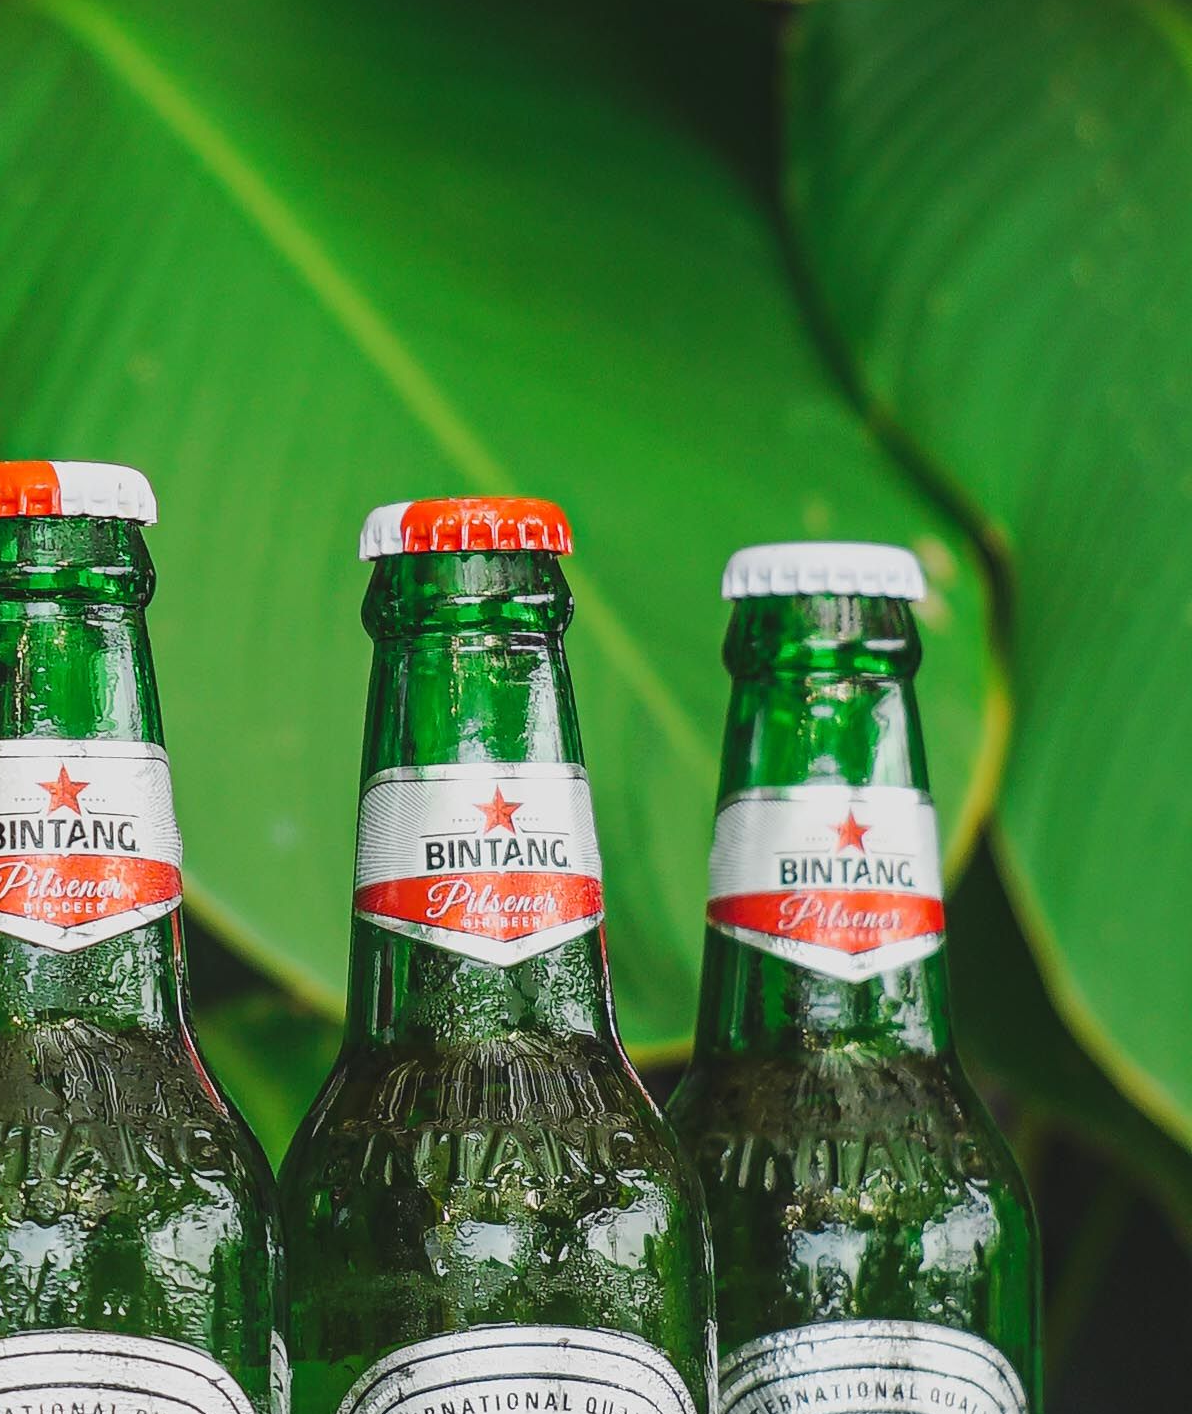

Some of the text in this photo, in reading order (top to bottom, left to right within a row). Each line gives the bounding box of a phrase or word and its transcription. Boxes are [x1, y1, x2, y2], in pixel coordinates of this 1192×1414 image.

[425, 838, 568, 871] BINTANG
[779, 857, 915, 887] BINTANG
[425, 878, 557, 919] Pilsener
[778, 893, 903, 930] Pilsener
